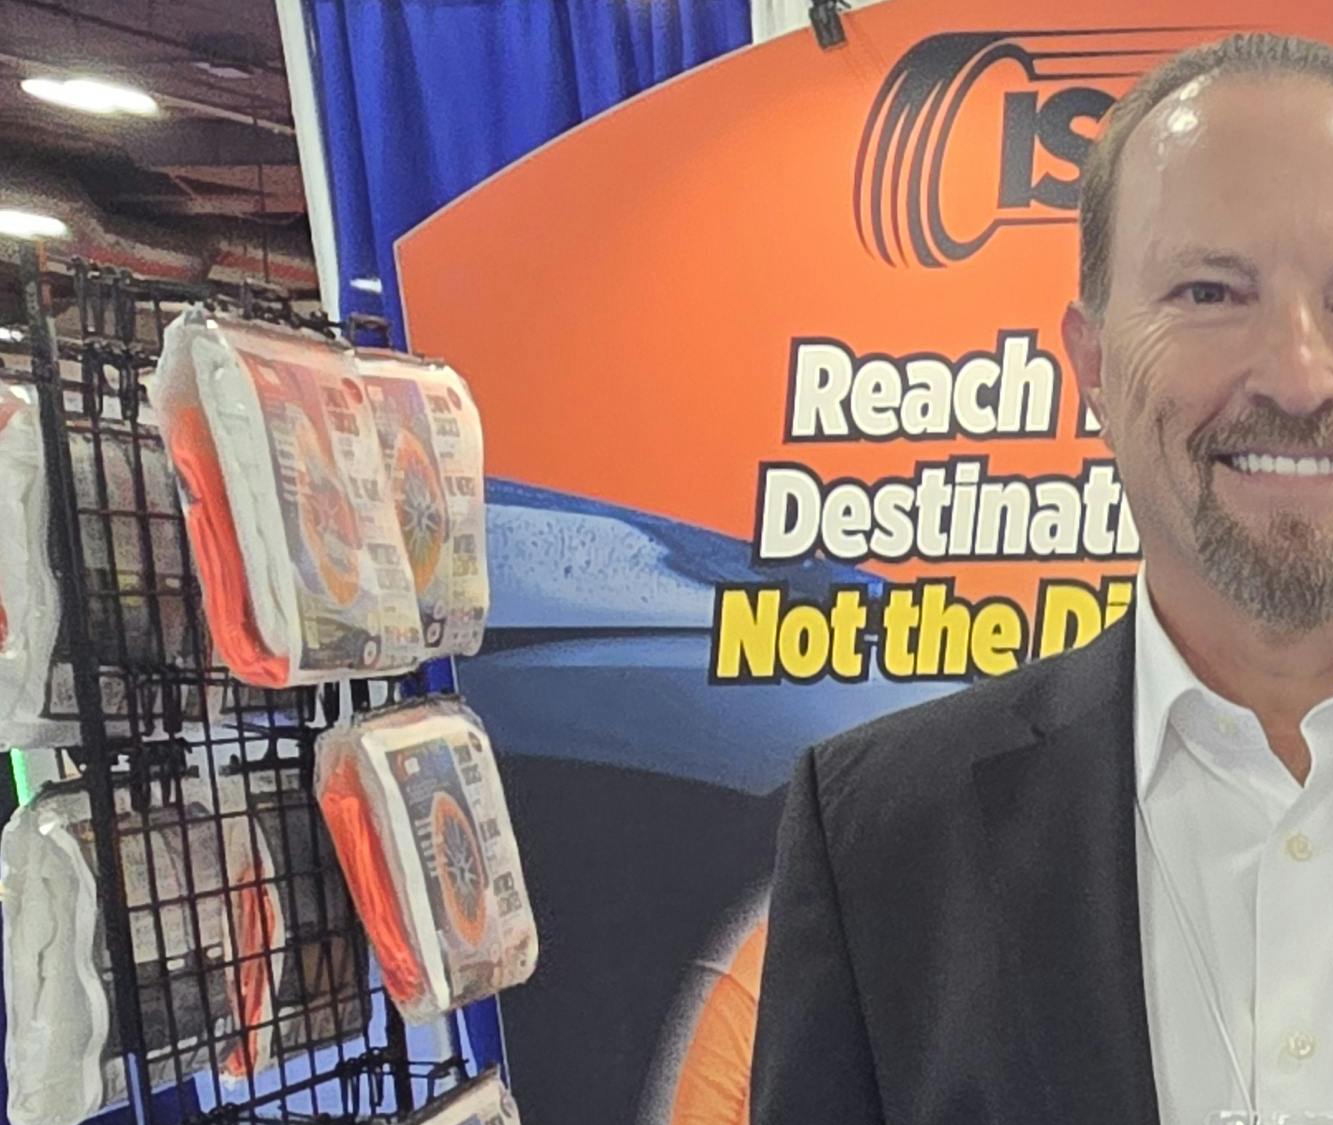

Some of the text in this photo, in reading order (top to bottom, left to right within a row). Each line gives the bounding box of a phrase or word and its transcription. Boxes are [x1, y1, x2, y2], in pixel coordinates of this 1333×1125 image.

[791, 336, 1055, 437] Reach
[716, 586, 867, 679] Not
[882, 584, 1021, 678] the
